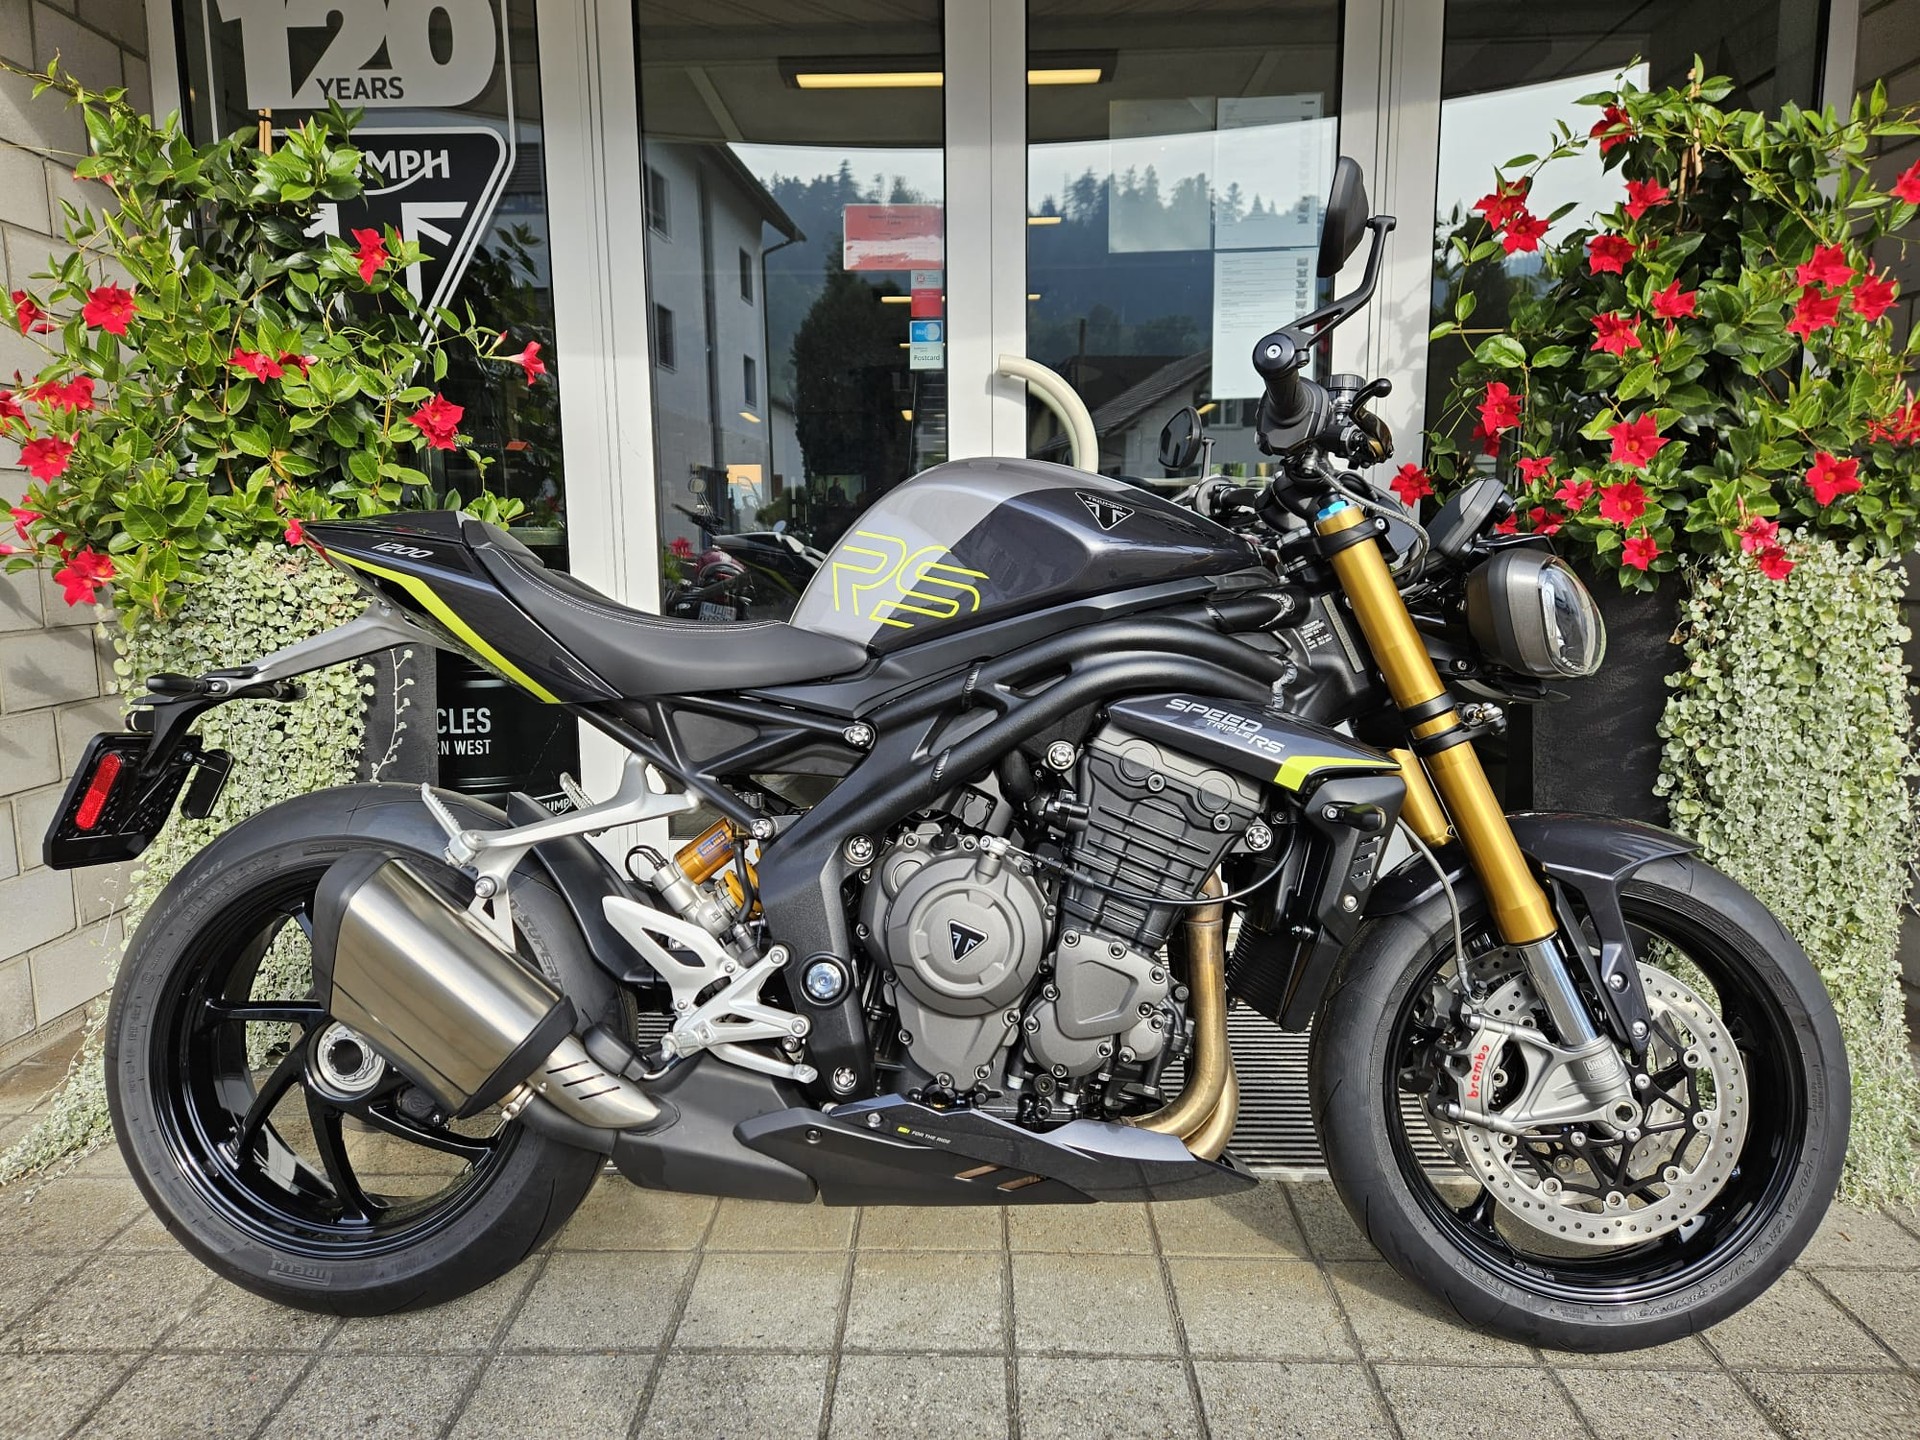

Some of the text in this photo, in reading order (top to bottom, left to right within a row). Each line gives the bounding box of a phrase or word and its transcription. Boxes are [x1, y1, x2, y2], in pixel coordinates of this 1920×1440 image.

[214, 0, 496, 109] 120
[316, 76, 405, 100] YEARS
[914, 354, 941, 362] Postcard
[371, 542, 434, 558] 1200
[832, 530, 990, 629] RS
[1165, 698, 1263, 733] SPEED
[454, 740, 491, 755] WEST
[1206, 719, 1286, 754] TRIPLE RS
[1467, 1044, 1490, 1098] brembo
[911, 1130, 924, 1138] FOR
[924, 1133, 936, 1141] THE
[268, 1254, 332, 1286] PIRELLI
